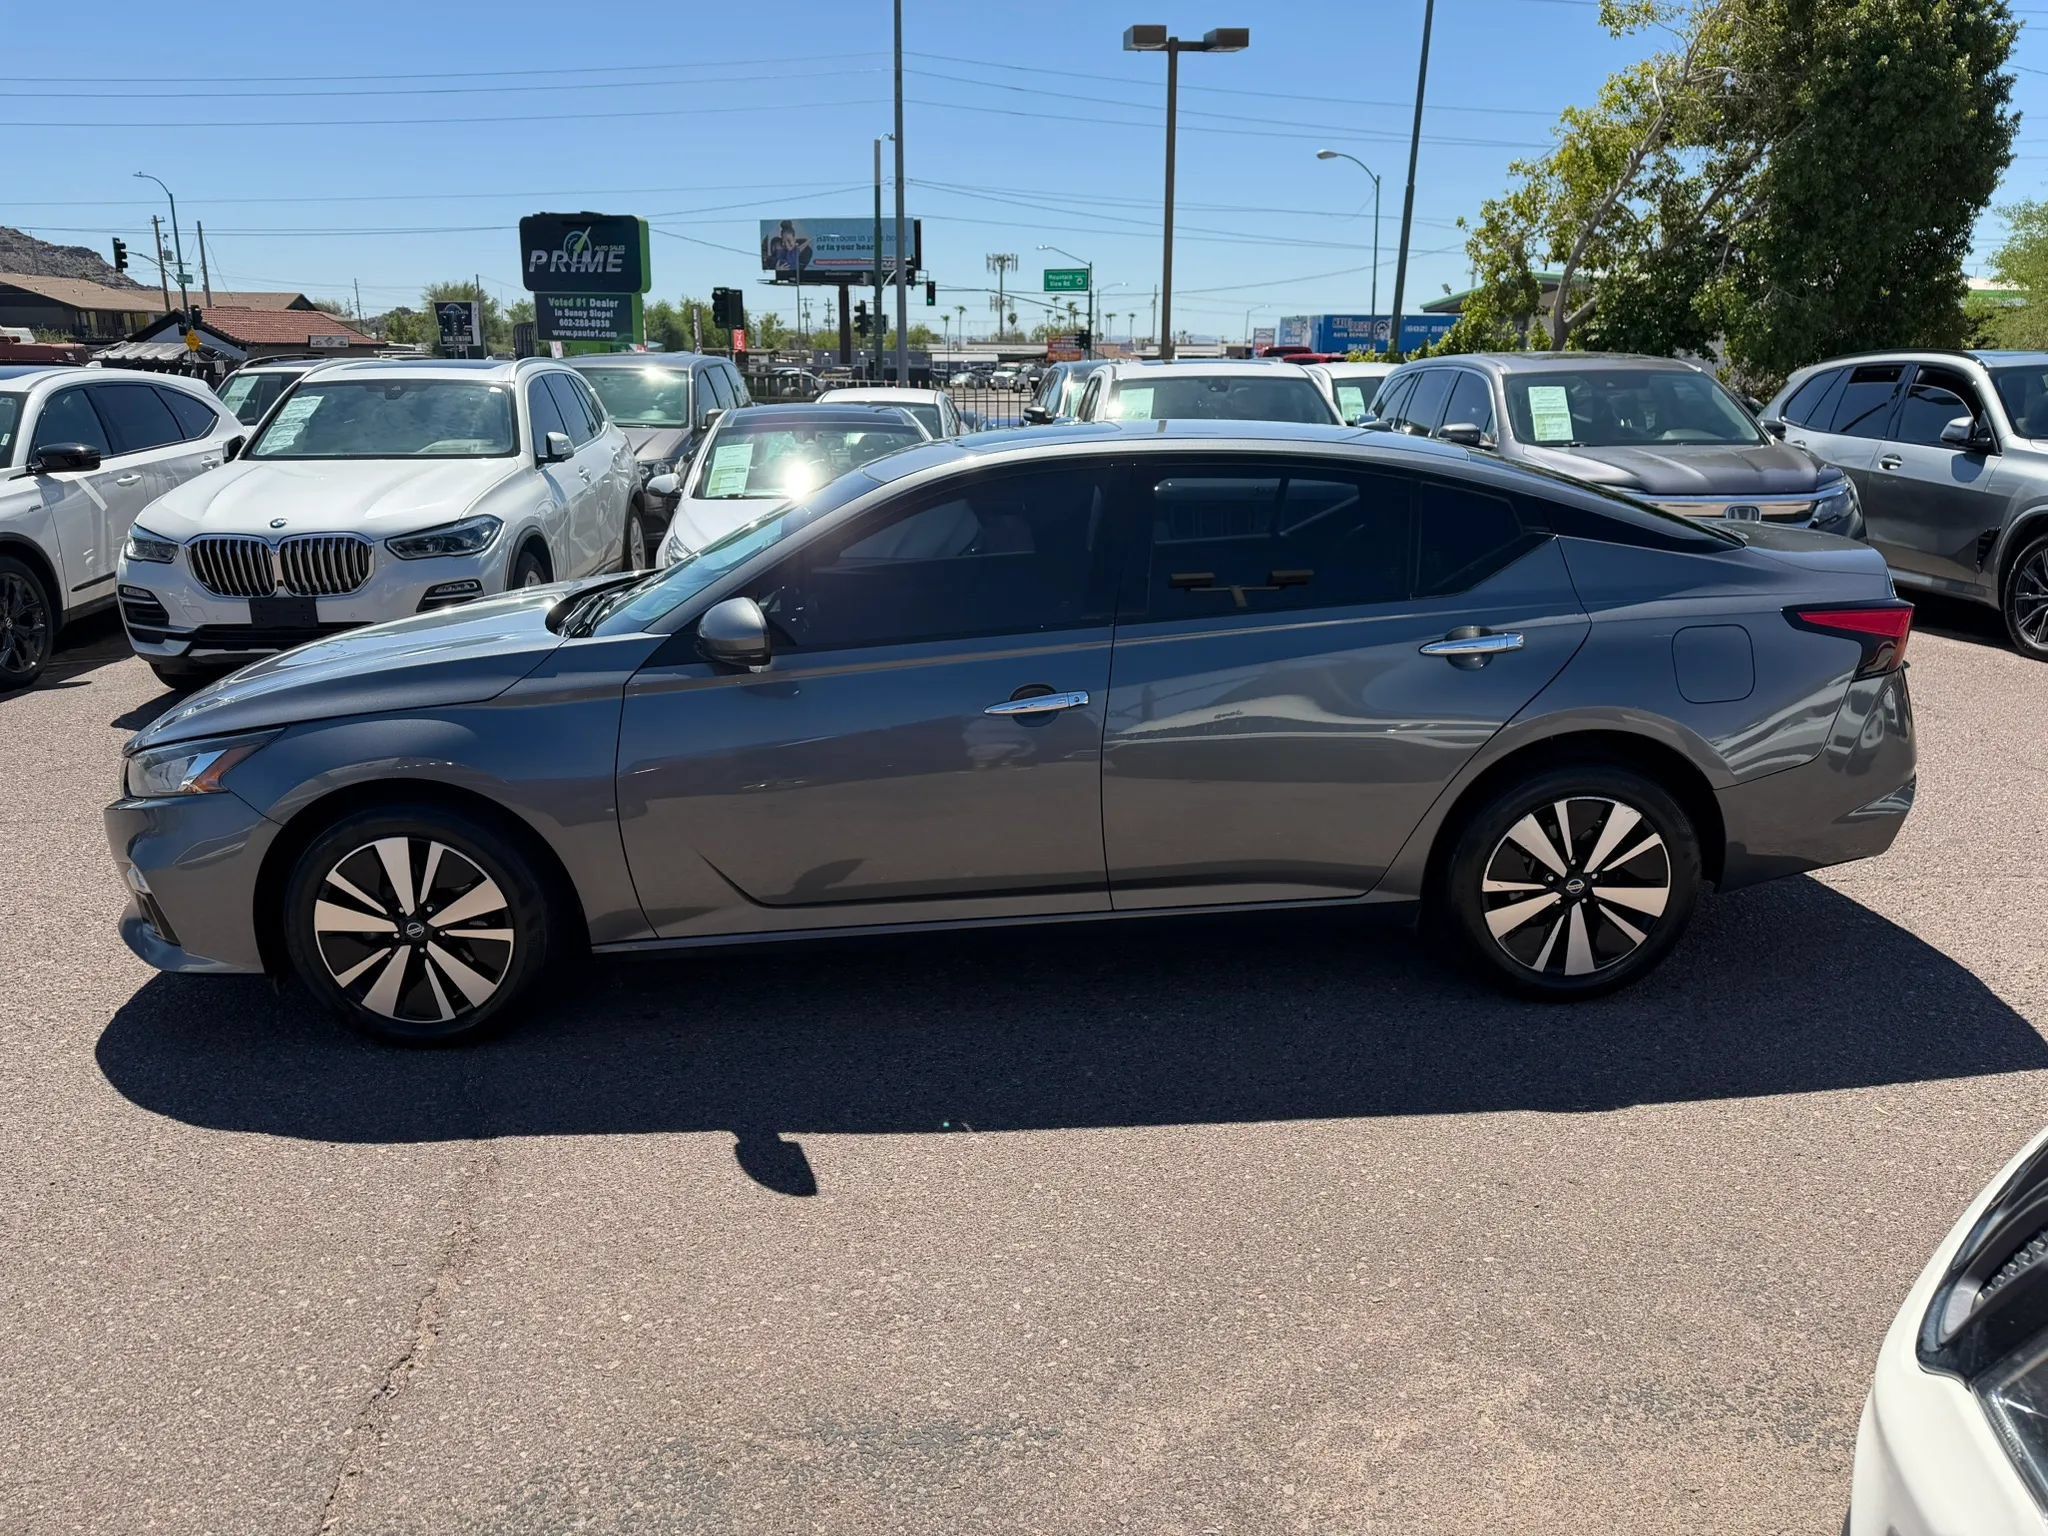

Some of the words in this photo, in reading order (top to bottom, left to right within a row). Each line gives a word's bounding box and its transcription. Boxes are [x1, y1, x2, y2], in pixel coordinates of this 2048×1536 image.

[856, 243, 875, 251] hear
[528, 250, 625, 272] PRIME
[548, 297, 574, 307] Voted
[576, 298, 586, 307] #1
[589, 298, 619, 308] Dealer
[564, 308, 588, 318] Sunny
[552, 329, 618, 338] www.pauto1.com
